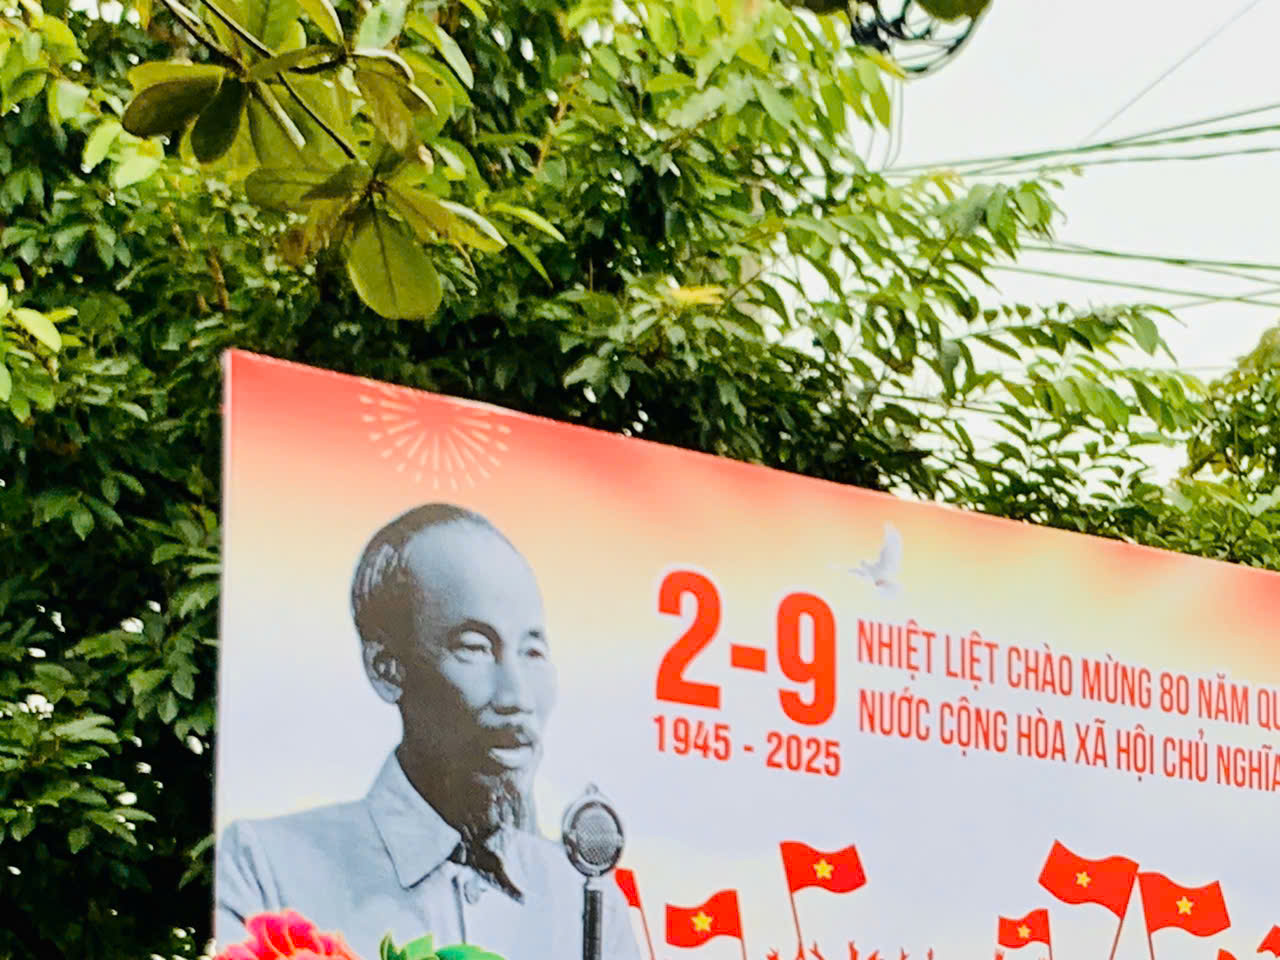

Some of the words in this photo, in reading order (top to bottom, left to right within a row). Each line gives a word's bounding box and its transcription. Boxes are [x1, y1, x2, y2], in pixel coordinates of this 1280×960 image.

[656, 569, 837, 726] 2-9
[857, 618, 936, 681] NHIỆT
[945, 630, 1000, 691] LIỆT
[1007, 642, 1072, 697] CHÀO
[1081, 654, 1152, 710] MỪNG
[1159, 672, 1190, 716] 80
[1198, 673, 1250, 726] NĂM
[653, 714, 731, 761] 1945
[766, 731, 841, 777] 2025
[858, 686, 930, 742] NƯỚC
[940, 696, 1008, 757] CỘNG
[1016, 707, 1066, 763] HÒA
[1075, 719, 1108, 769] XÃ
[1116, 723, 1154, 782] HỘI
[1163, 728, 1208, 783] CHỦ
